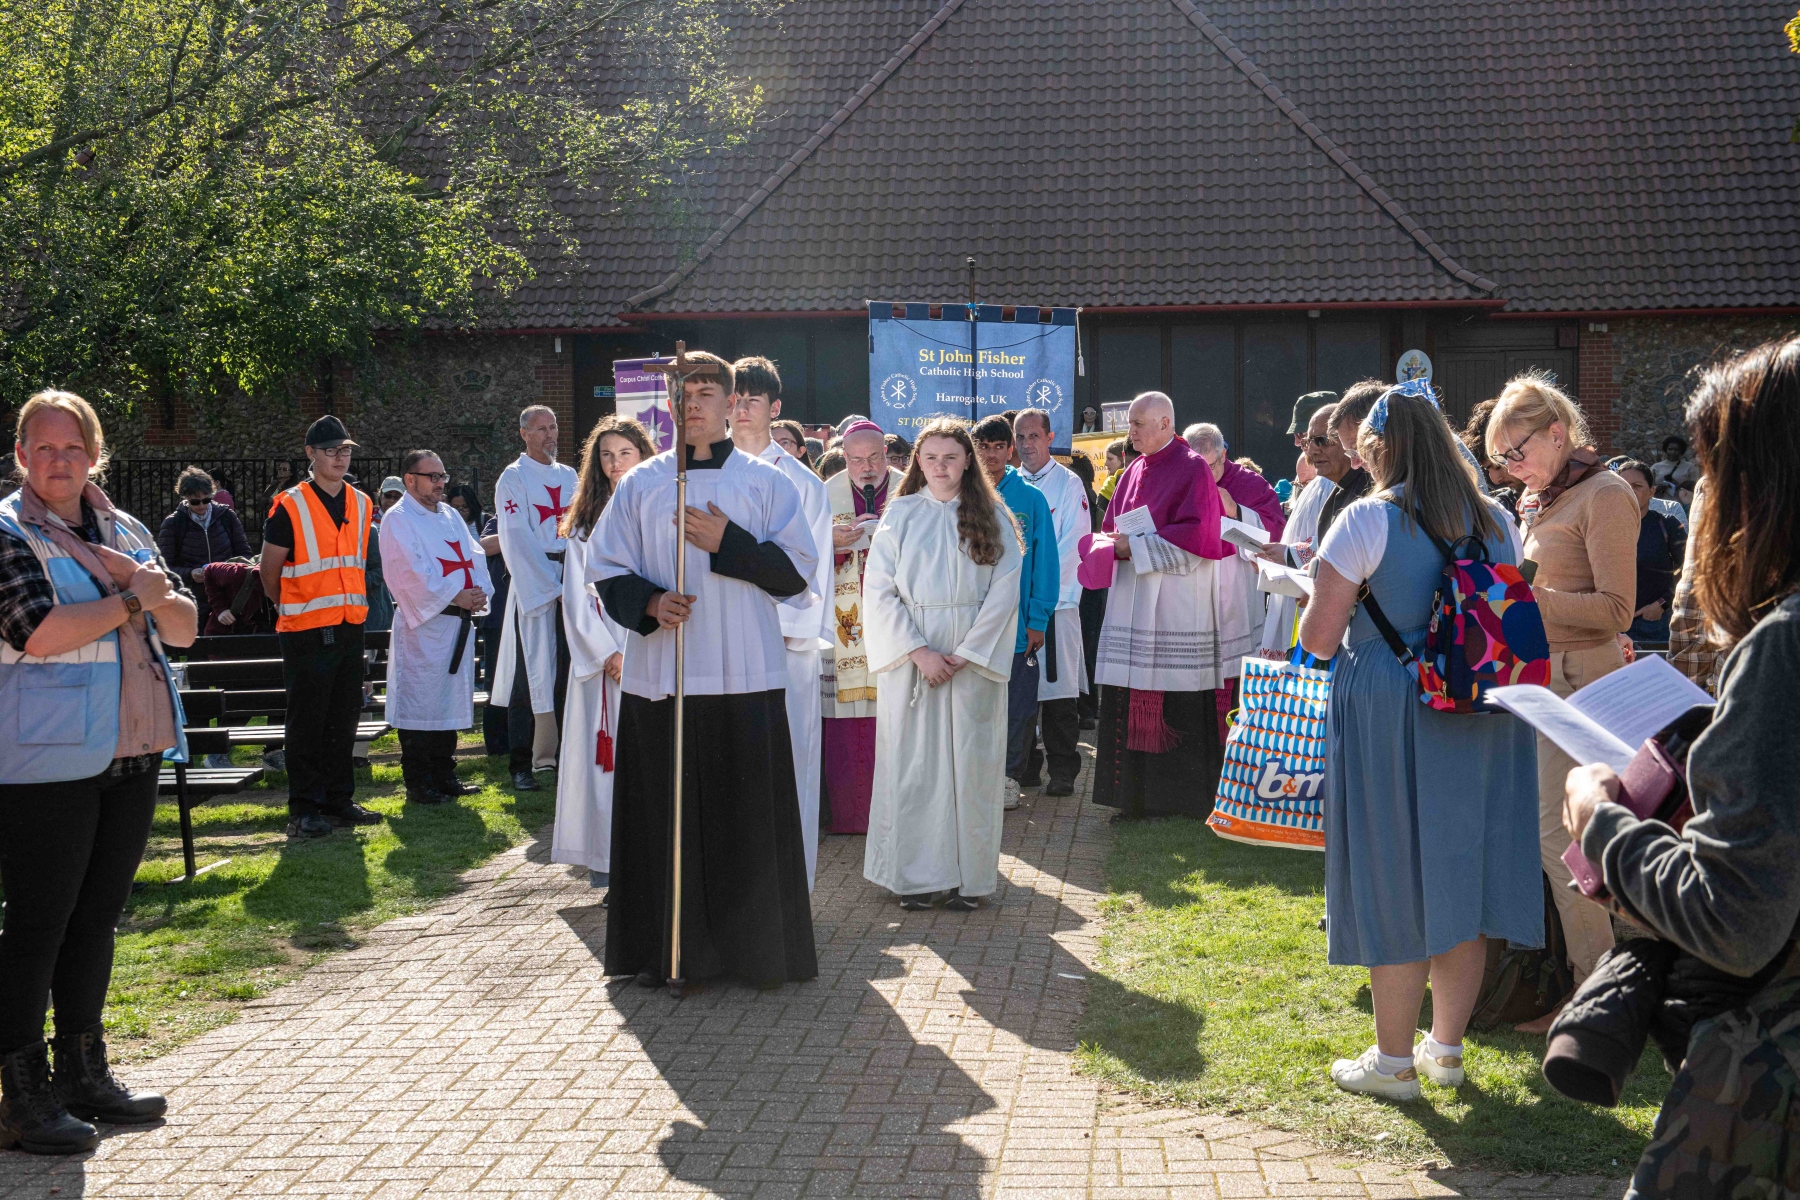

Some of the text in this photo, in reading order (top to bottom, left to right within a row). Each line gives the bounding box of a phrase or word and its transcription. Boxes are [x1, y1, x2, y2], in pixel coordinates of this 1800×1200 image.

[919, 349, 1026, 365] St John Fisher
[919, 366, 1024, 380] Catholic High School
[935, 392, 1008, 406] Harrogate, UK
[897, 417, 910, 426] ST
